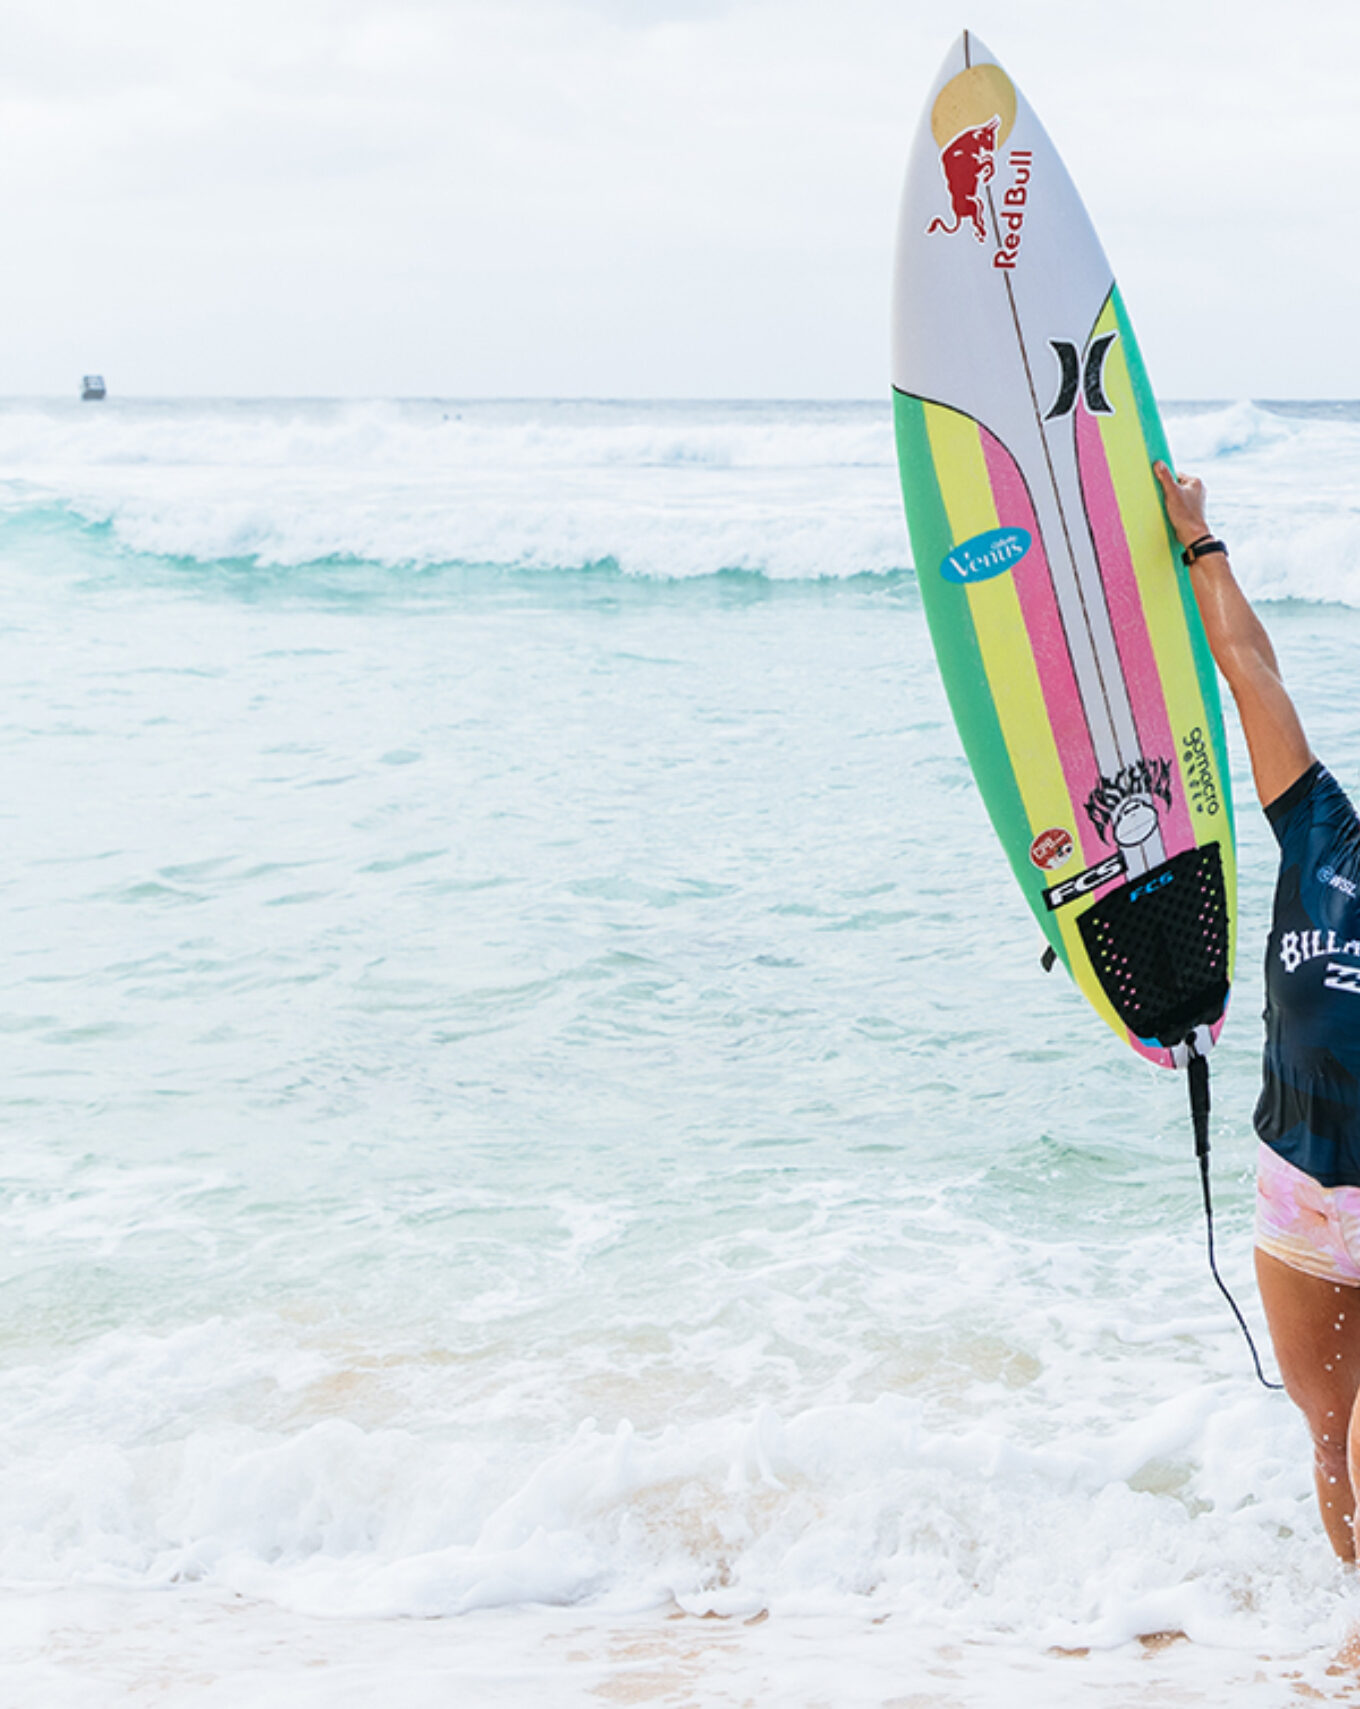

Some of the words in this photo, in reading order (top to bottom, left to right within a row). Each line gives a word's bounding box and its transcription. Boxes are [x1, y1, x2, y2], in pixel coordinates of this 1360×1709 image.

[1004, 151, 1033, 206] Bull
[993, 212, 1023, 269] Red
[948, 545, 1023, 577] Venus
[1050, 856, 1122, 906] FCS
[1329, 874, 1356, 899] WSL
